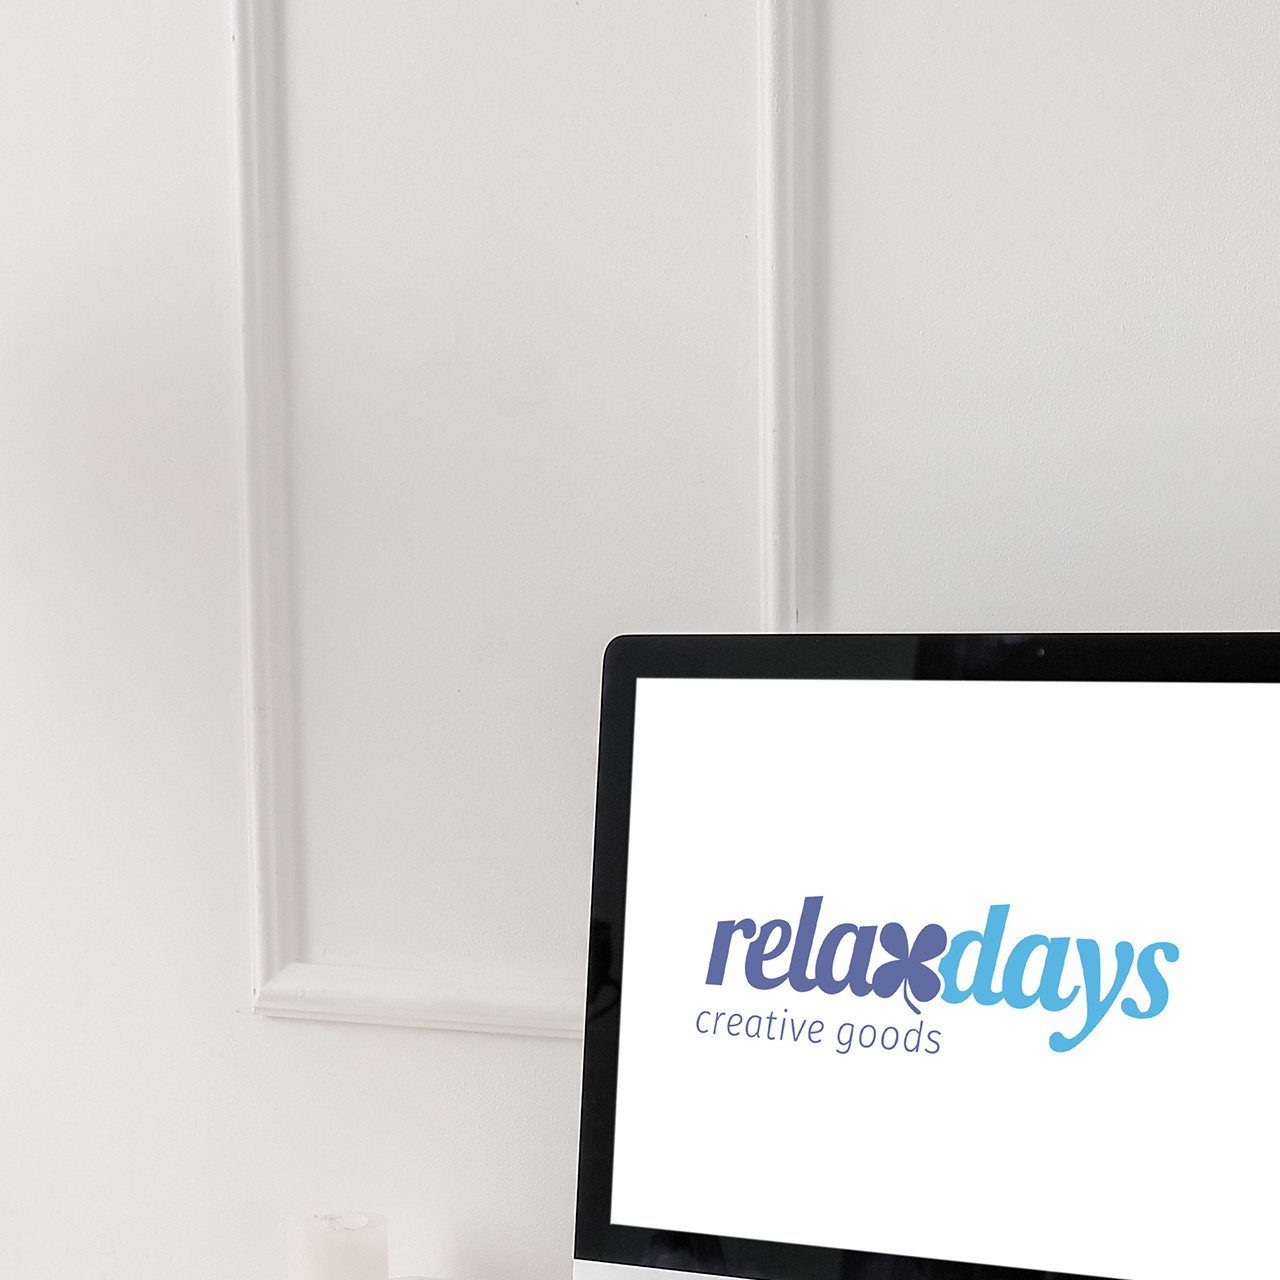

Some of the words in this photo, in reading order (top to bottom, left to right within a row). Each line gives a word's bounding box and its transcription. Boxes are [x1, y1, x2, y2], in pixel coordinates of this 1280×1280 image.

[704, 895, 1180, 1054] relaxdays
[694, 1008, 826, 1045] creative
[835, 1020, 943, 1056] goods
